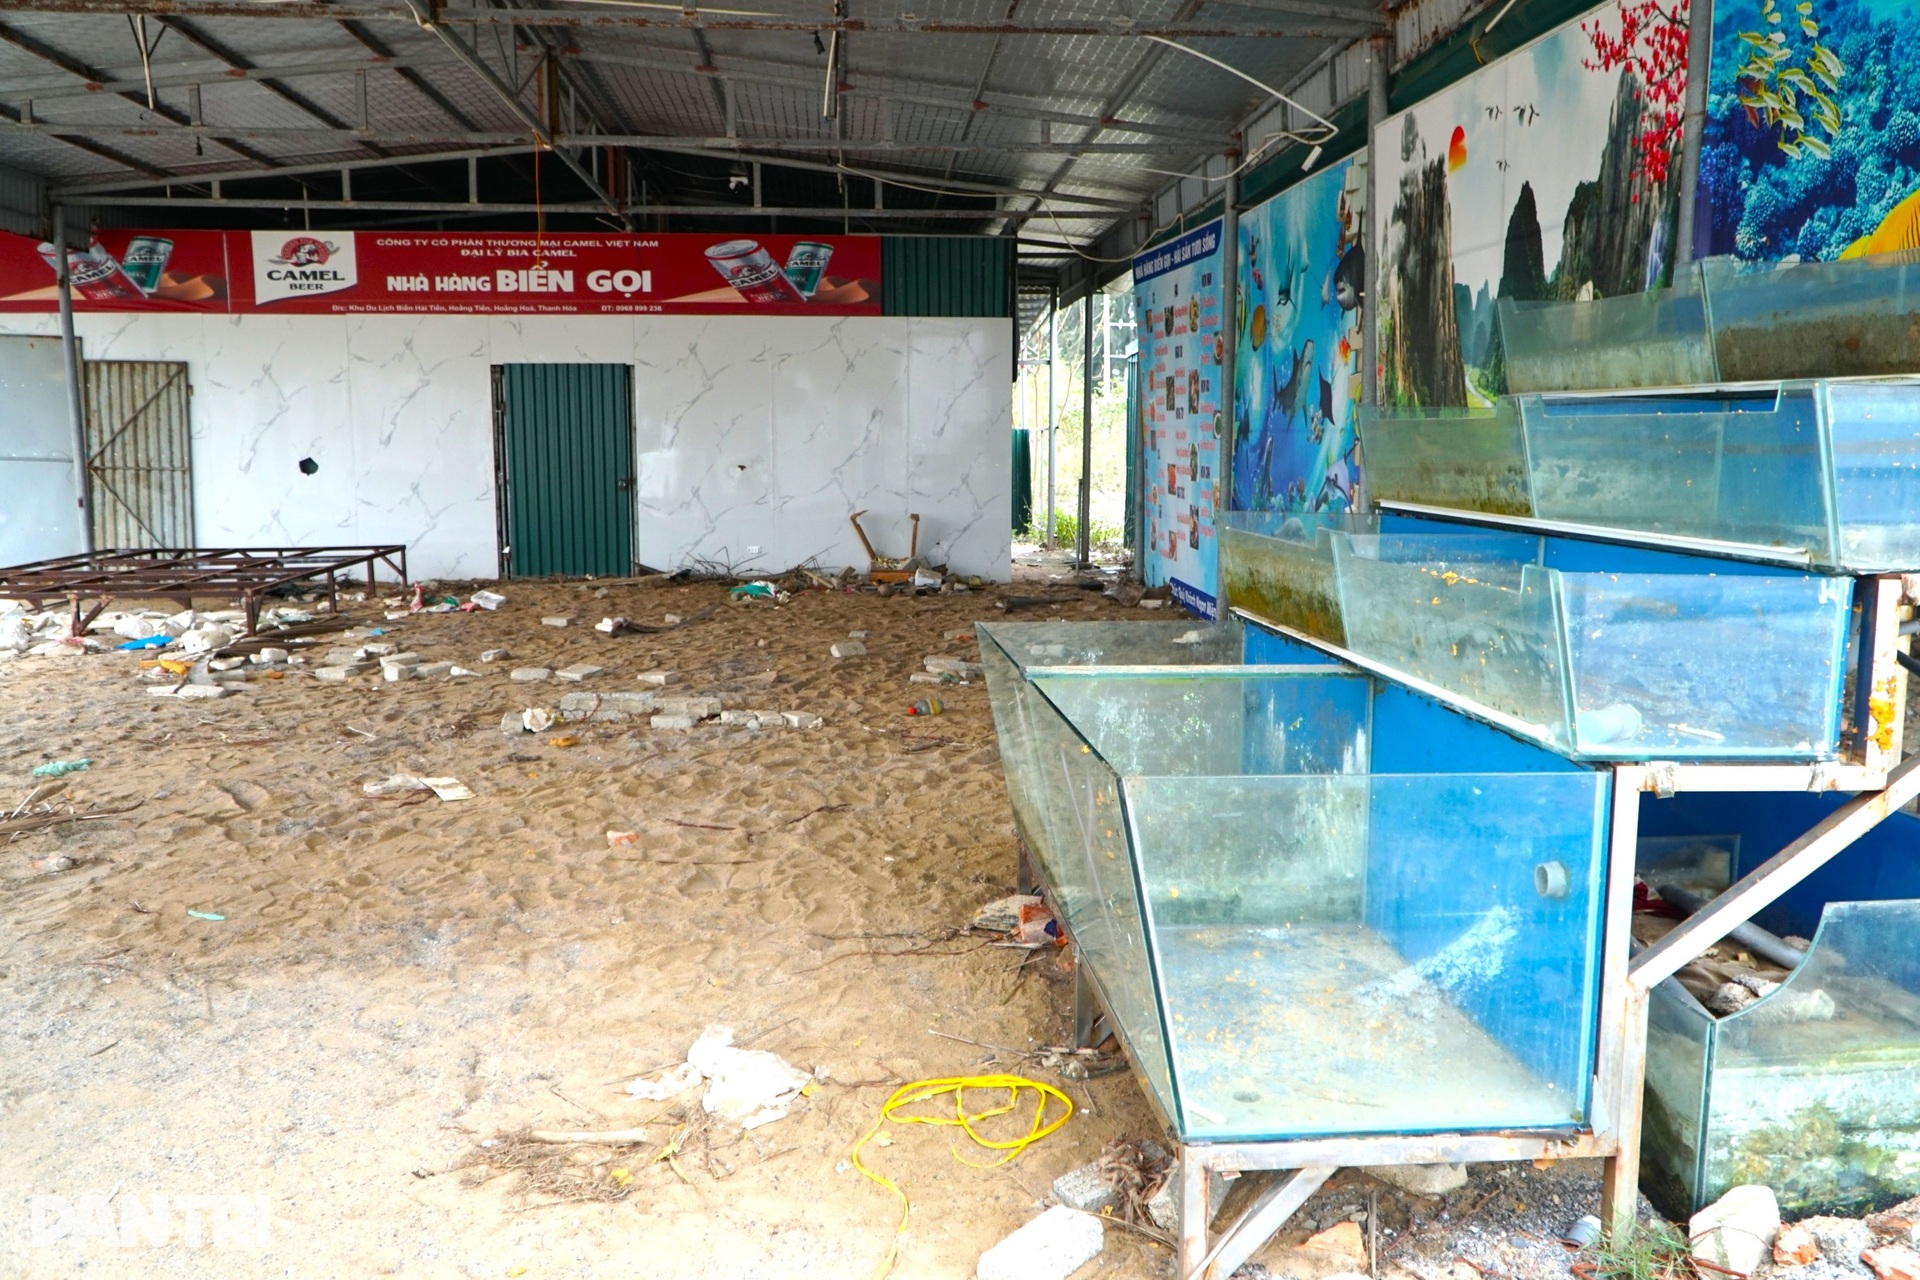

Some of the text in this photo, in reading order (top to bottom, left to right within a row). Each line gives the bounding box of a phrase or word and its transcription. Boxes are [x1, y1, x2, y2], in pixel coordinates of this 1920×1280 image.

[376, 237, 411, 247] CÔNG
[414, 239, 428, 247] TY
[486, 239, 537, 247] THƯƠNG
[540, 240, 561, 249] MẠI
[563, 239, 603, 247] CAMEL
[605, 239, 630, 248] VIỆT
[633, 240, 659, 248] NAM
[461, 247, 577, 258] ĐẠI LÝ BIA CAMEL
[266, 270, 346, 281] CAMEL
[387, 261, 652, 298] NHÀ HÀNG BIỂN GỌI
[732, 268, 777, 287] CAMEL
[378, 304, 395, 312] Lịch
